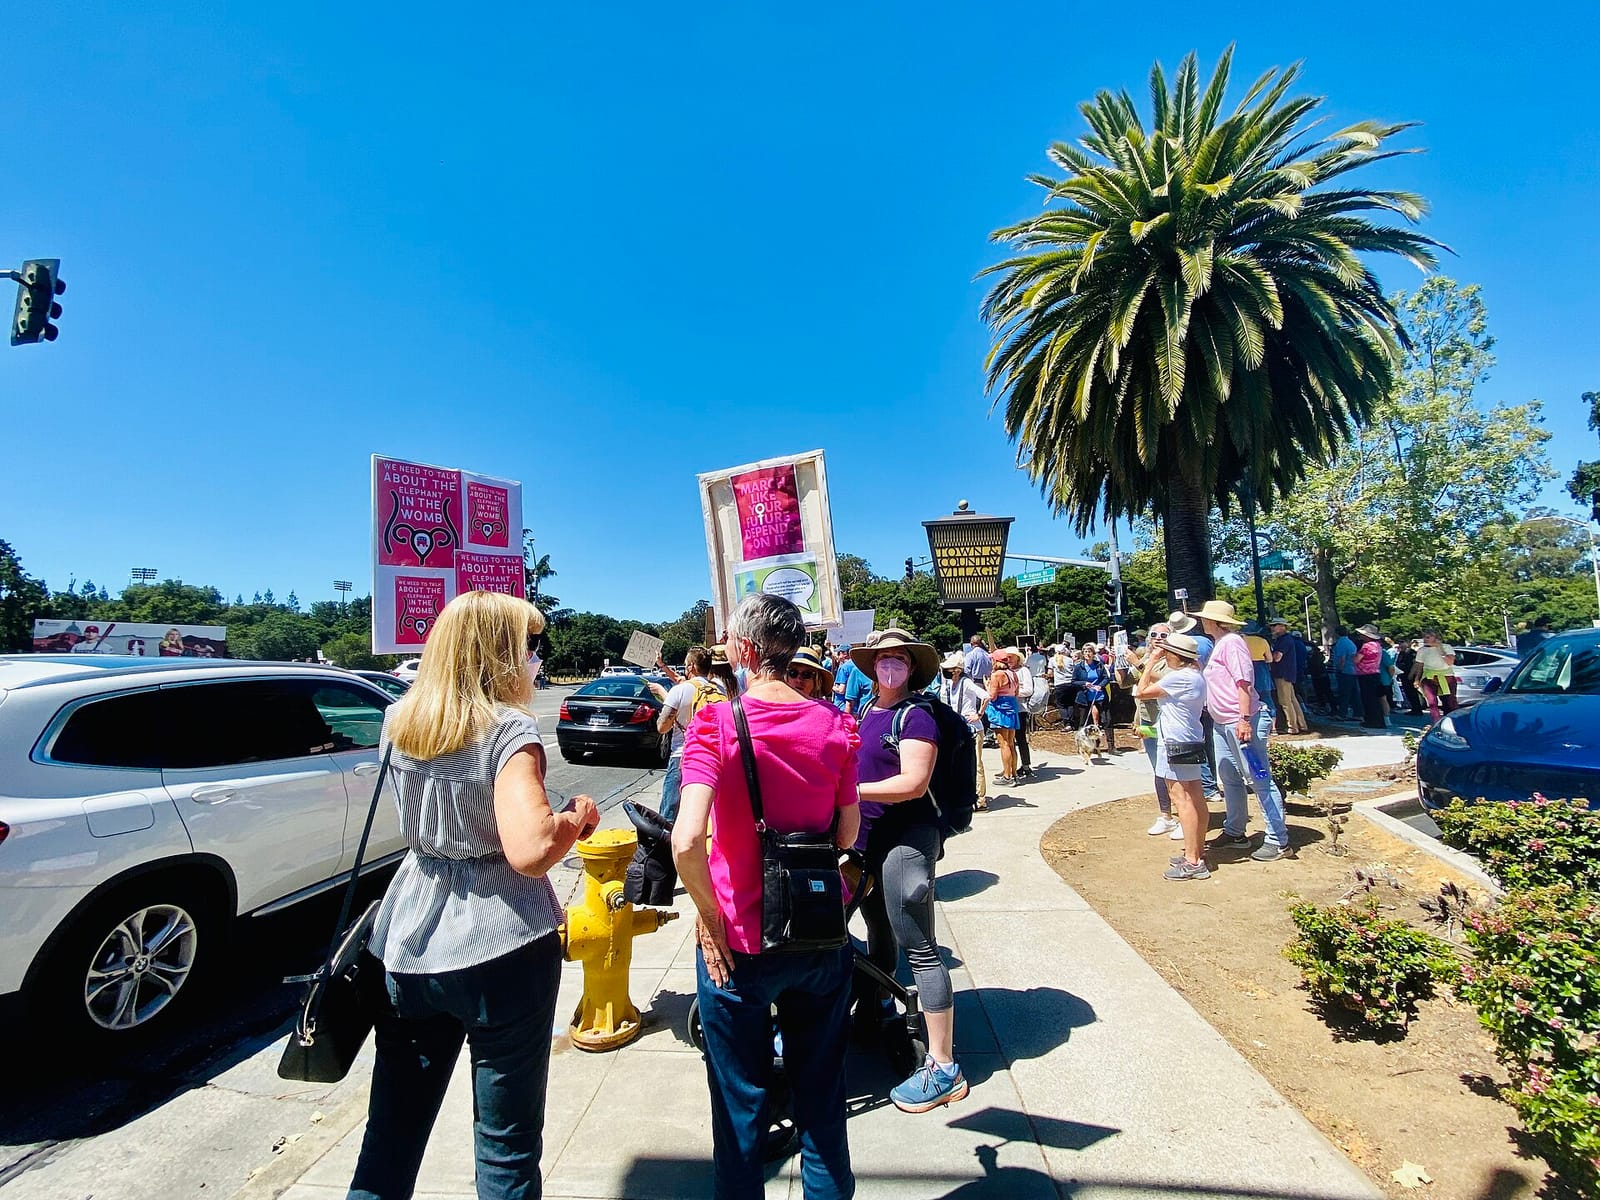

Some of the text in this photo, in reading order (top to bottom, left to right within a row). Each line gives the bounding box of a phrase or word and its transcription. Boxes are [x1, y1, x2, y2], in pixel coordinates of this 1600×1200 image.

[400, 465, 420, 474] NEED
[384, 472, 456, 491] ABOUT THE
[741, 477, 785, 495] MARCH
[399, 486, 442, 498] ELEPHANT
[751, 491, 776, 504] LIKE
[402, 496, 440, 510] IN THE
[748, 501, 783, 515] YOUR
[401, 509, 442, 523] WOMB
[746, 511, 790, 528] FUTURE
[753, 536, 770, 549] ON
[936, 546, 1001, 557] TOWN &
[461, 562, 520, 574] ABOUT THE
[939, 557, 999, 567] COUNTRY
[939, 567, 998, 577] VILLAGE
[488, 584, 509, 592] THE
